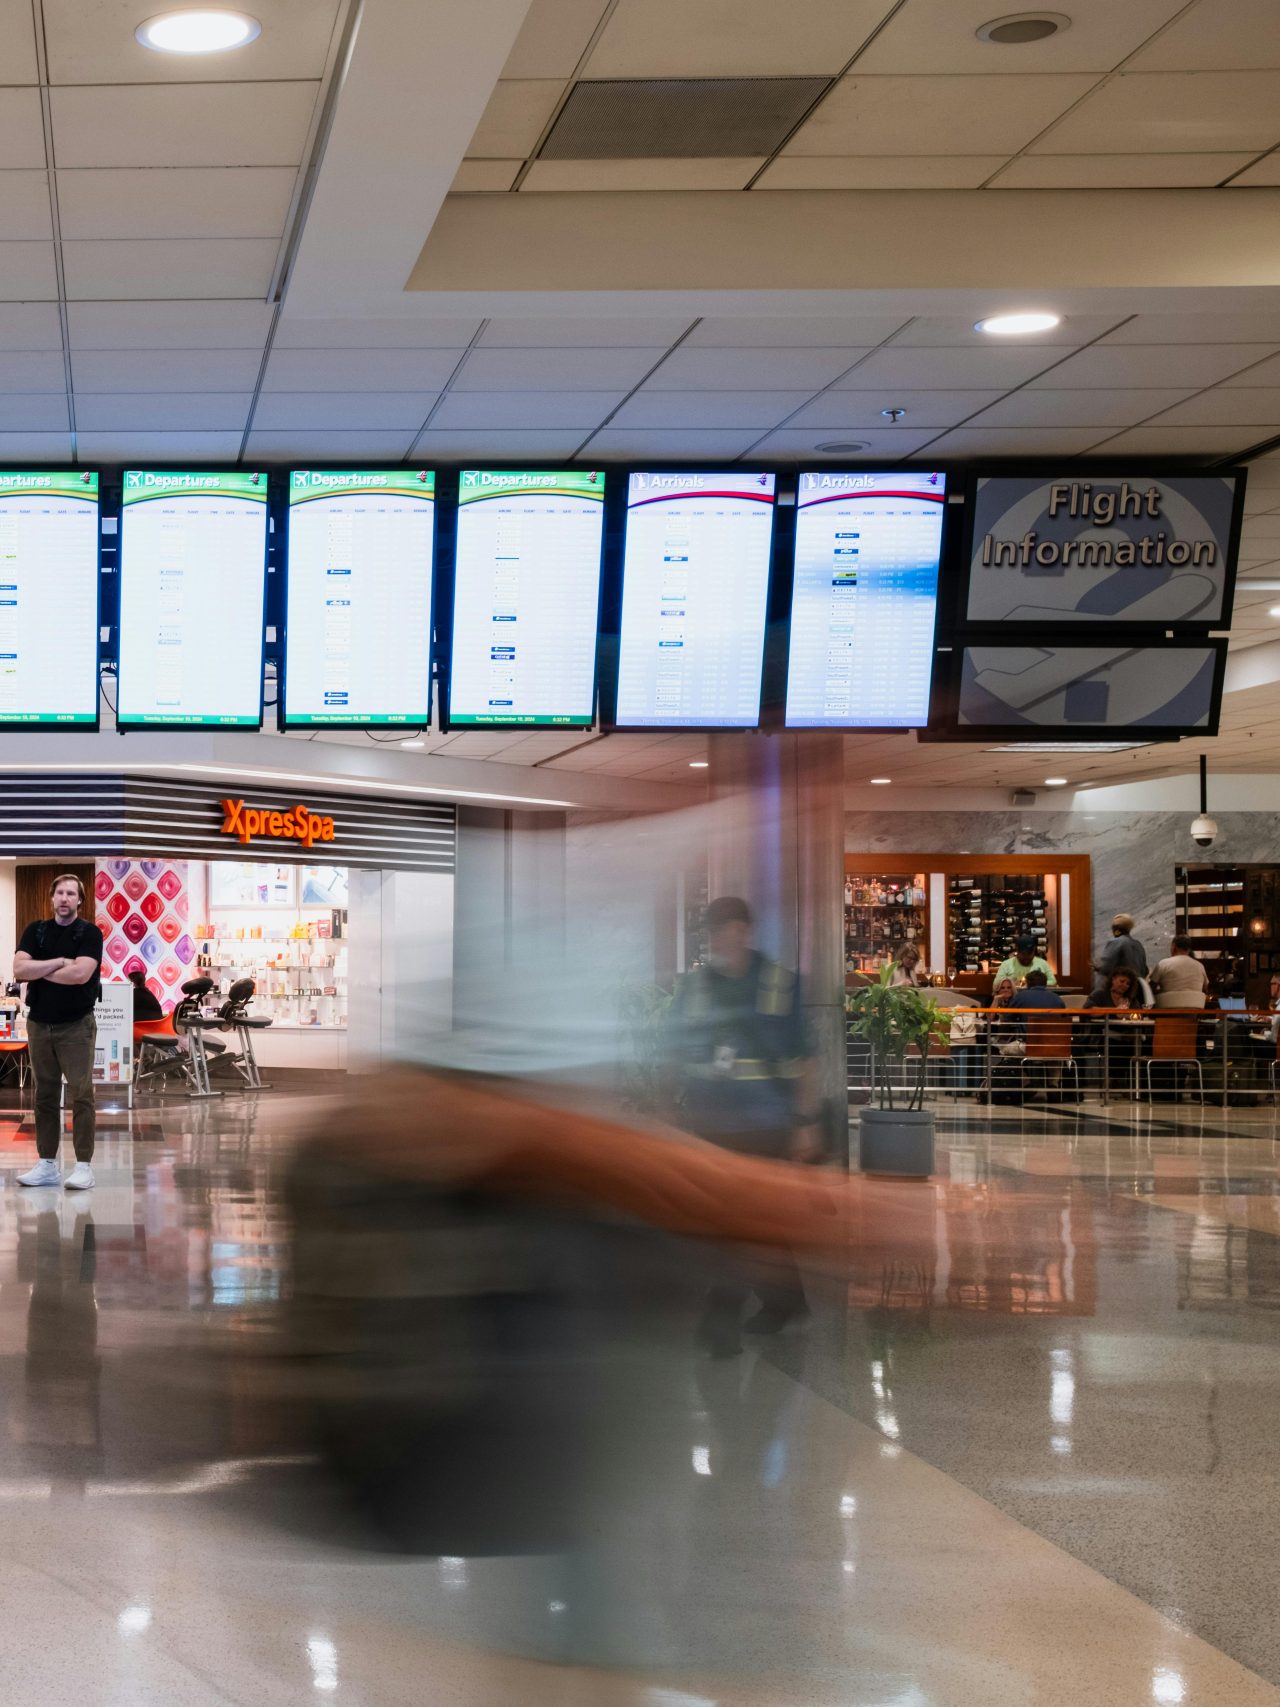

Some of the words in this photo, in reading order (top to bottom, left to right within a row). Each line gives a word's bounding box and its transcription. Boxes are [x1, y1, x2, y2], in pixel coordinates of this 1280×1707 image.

[145, 474, 220, 489] Departures
[311, 473, 388, 488] Departures
[481, 473, 557, 488] Departures
[650, 475, 705, 488] Arrivals
[820, 474, 875, 488] Arrivals
[1049, 482, 1161, 525] Flight
[982, 531, 1217, 566] Information
[221, 799, 335, 847] XpresSpa
